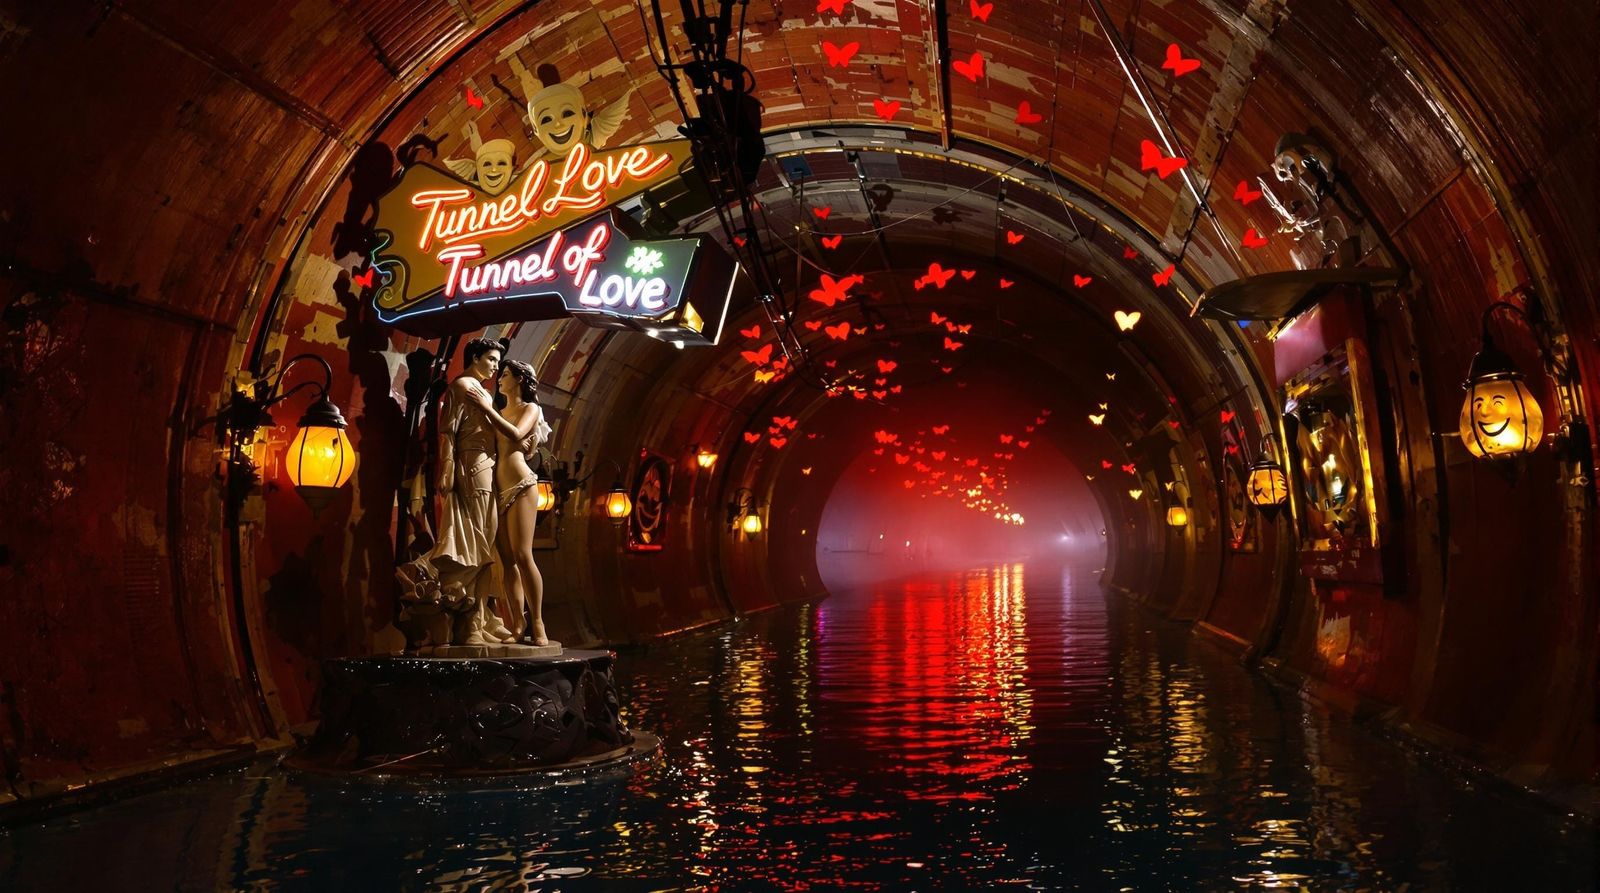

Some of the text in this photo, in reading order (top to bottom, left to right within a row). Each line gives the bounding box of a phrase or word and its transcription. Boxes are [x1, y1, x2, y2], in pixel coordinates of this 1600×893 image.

[411, 143, 673, 250] Tunnel Love
[437, 223, 612, 299] Tunnel of
